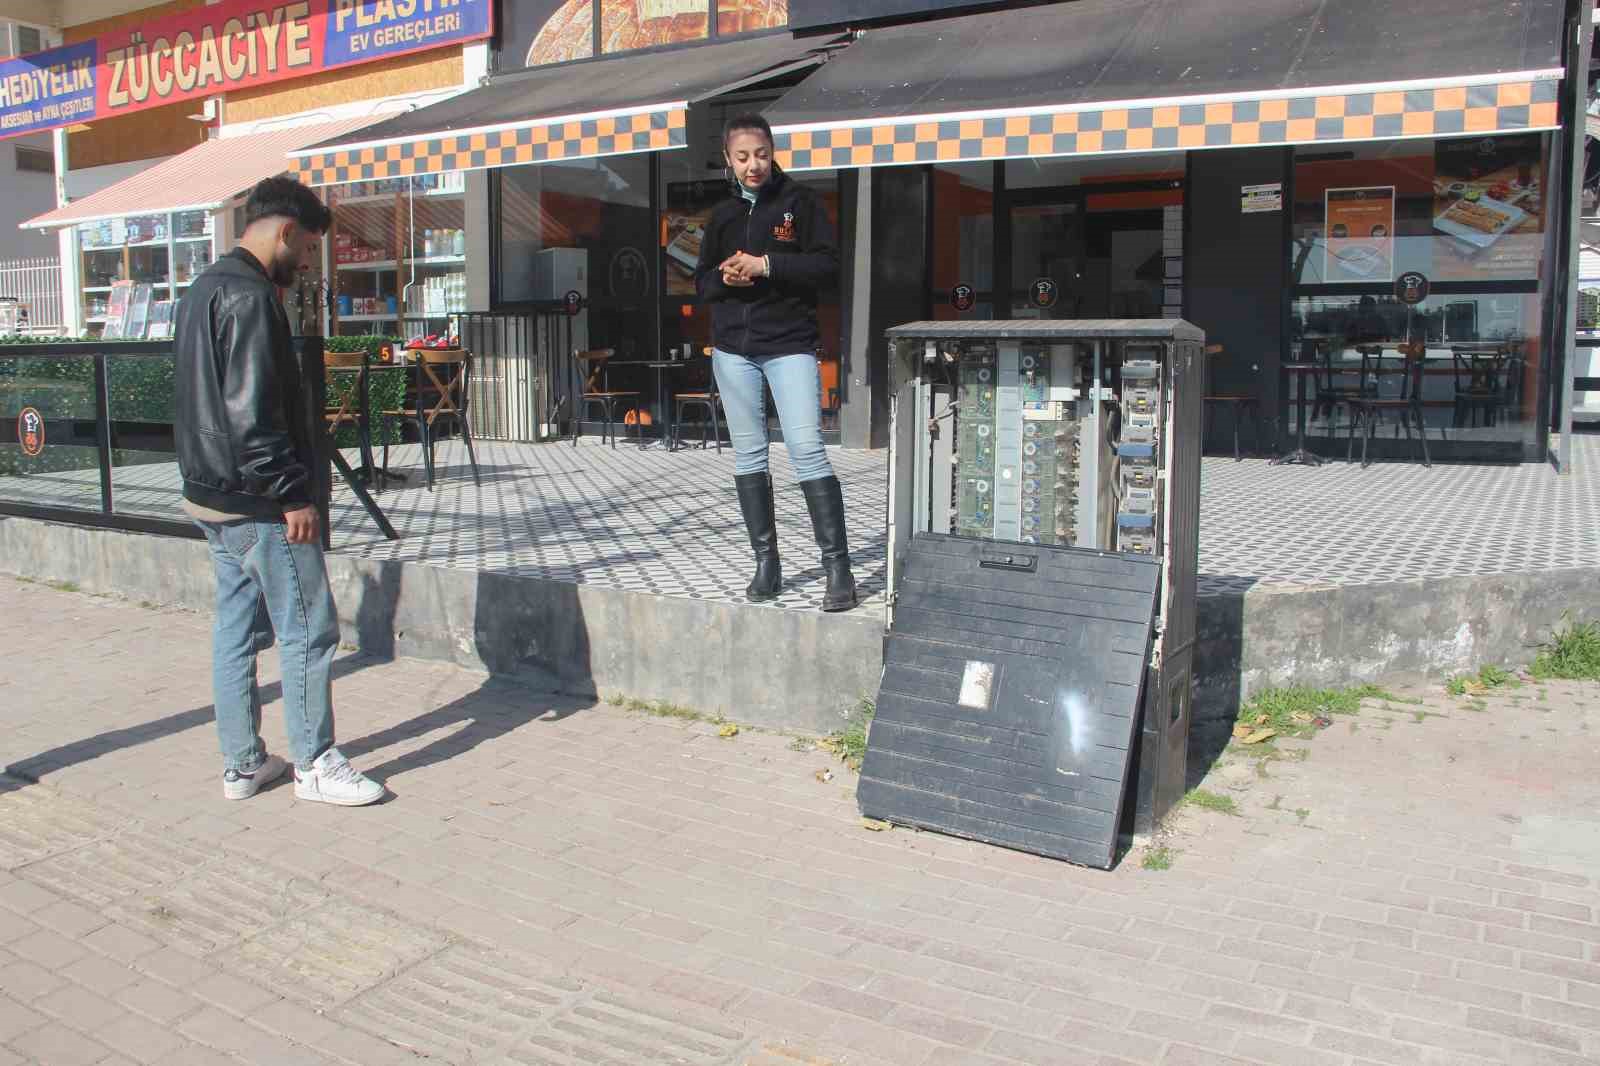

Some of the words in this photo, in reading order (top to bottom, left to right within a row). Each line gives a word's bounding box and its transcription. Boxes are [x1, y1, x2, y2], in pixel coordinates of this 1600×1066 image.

[351, 33, 369, 52] EV
[374, 13, 460, 48] GEREÇLERİ
[107, 3, 311, 107] ZÜCCACİYE
[0, 57, 93, 107] HEDİYELİK
[382, 346, 389, 361] 5
